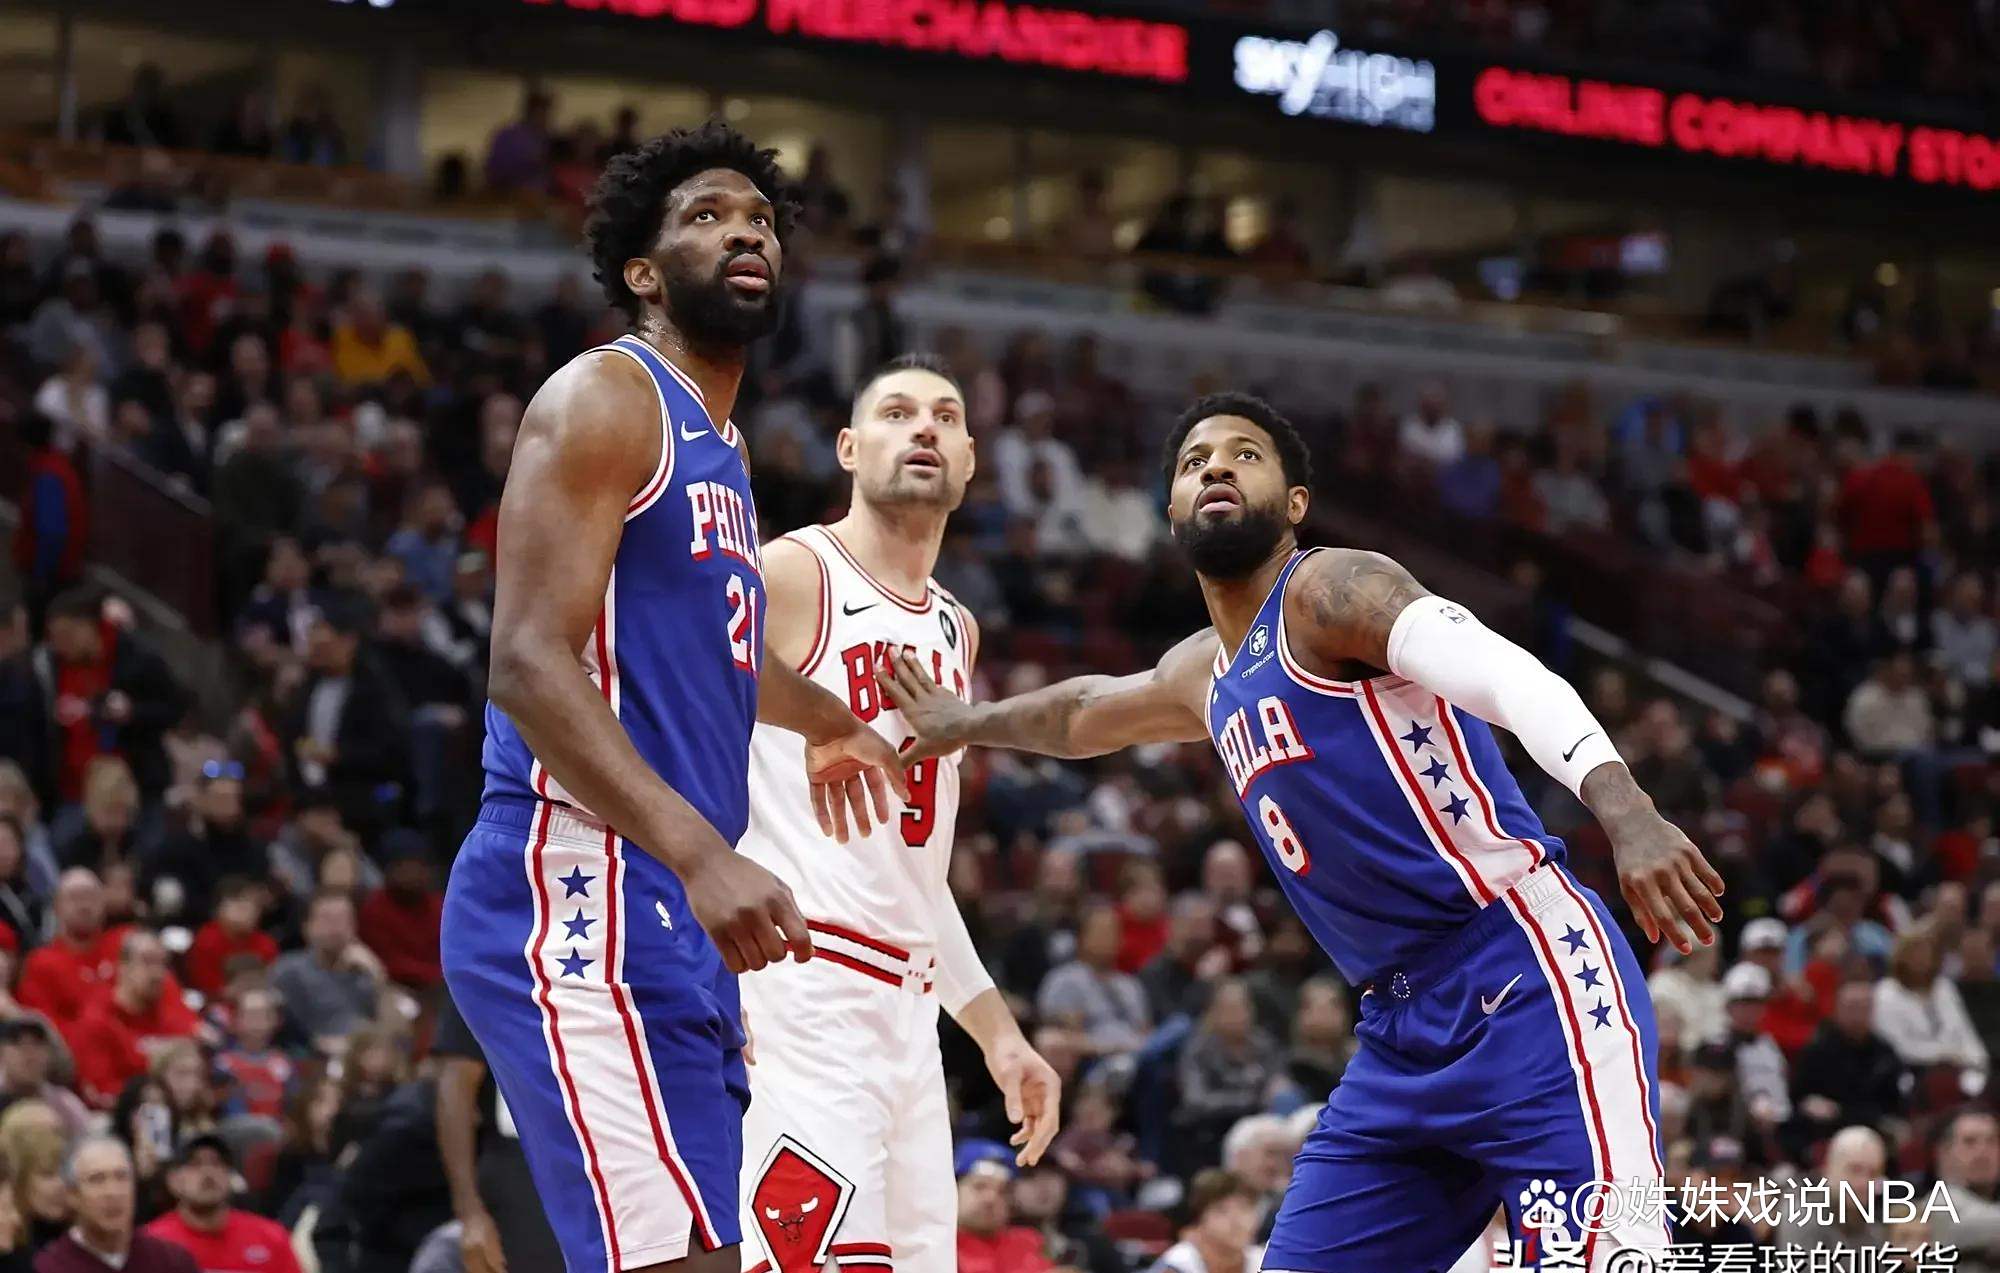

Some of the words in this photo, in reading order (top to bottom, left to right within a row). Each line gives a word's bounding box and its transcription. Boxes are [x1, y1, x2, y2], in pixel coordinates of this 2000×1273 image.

[726, 573, 758, 673] 21
[1218, 695, 1315, 800] HILA
[1259, 794, 1311, 876] 8
